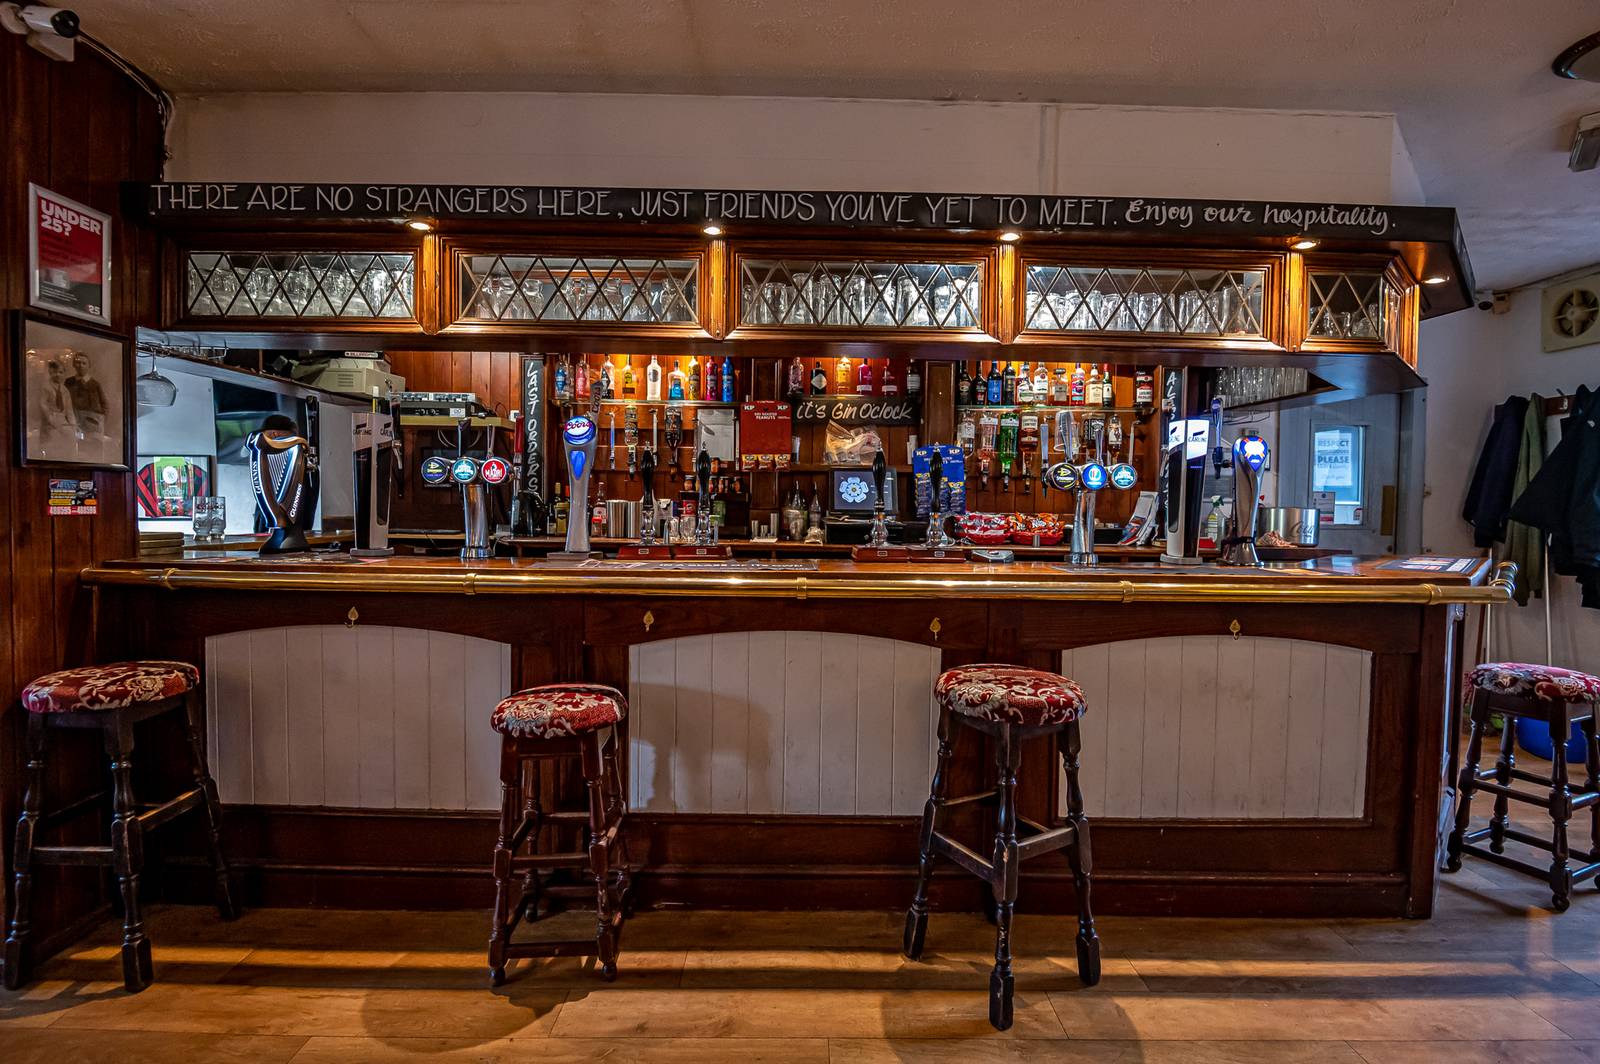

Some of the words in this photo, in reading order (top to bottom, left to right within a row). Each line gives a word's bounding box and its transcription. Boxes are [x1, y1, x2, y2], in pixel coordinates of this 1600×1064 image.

[41, 199, 101, 236] UNDER
[41, 214, 72, 236] 25?
[151, 184, 239, 209] THERE
[247, 185, 306, 210] ARE
[316, 186, 354, 211] NO
[366, 186, 528, 213] STRANGERS
[631, 191, 694, 218] JUST
[704, 192, 815, 220] FRIENDS
[826, 193, 914, 222] YOU'VE
[926, 195, 982, 224] YET
[993, 196, 1027, 225] TO
[1039, 198, 1117, 226] MEET.
[1125, 199, 1194, 228] Enjoy
[1203, 203, 1254, 223] our
[1263, 204, 1396, 235] hospitality.
[527, 362, 540, 415] LAST
[564, 420, 592, 432] Coors
[796, 401, 827, 419] it's
[831, 402, 857, 420] Gin
[859, 402, 912, 420] O'clock
[527, 418, 540, 492] ORDERS
[1317, 456, 1350, 464] PLEASE
[289, 483, 303, 518] GUINNESS
